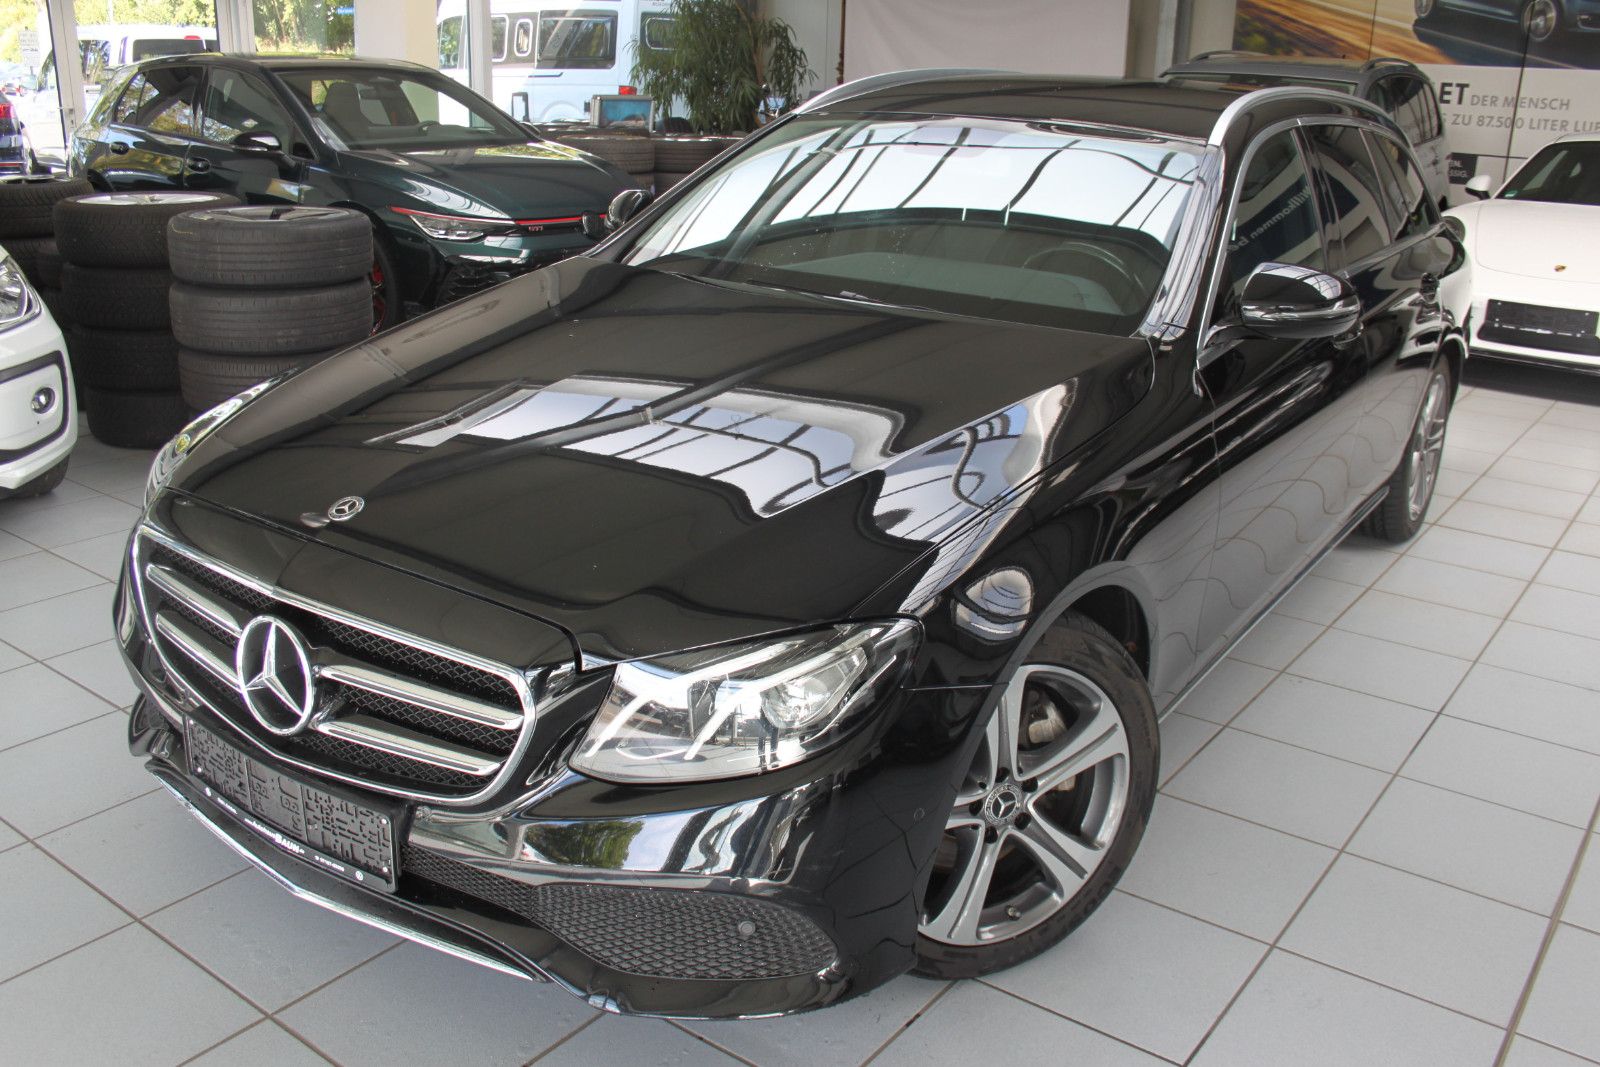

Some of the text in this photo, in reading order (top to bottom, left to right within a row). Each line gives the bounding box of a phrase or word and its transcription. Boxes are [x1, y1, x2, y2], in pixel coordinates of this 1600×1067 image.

[1470, 94, 1498, 107] DER
[1502, 96, 1570, 111] MENSCH
[1451, 113, 1472, 126] ZU
[1528, 117, 1569, 132] LITER
